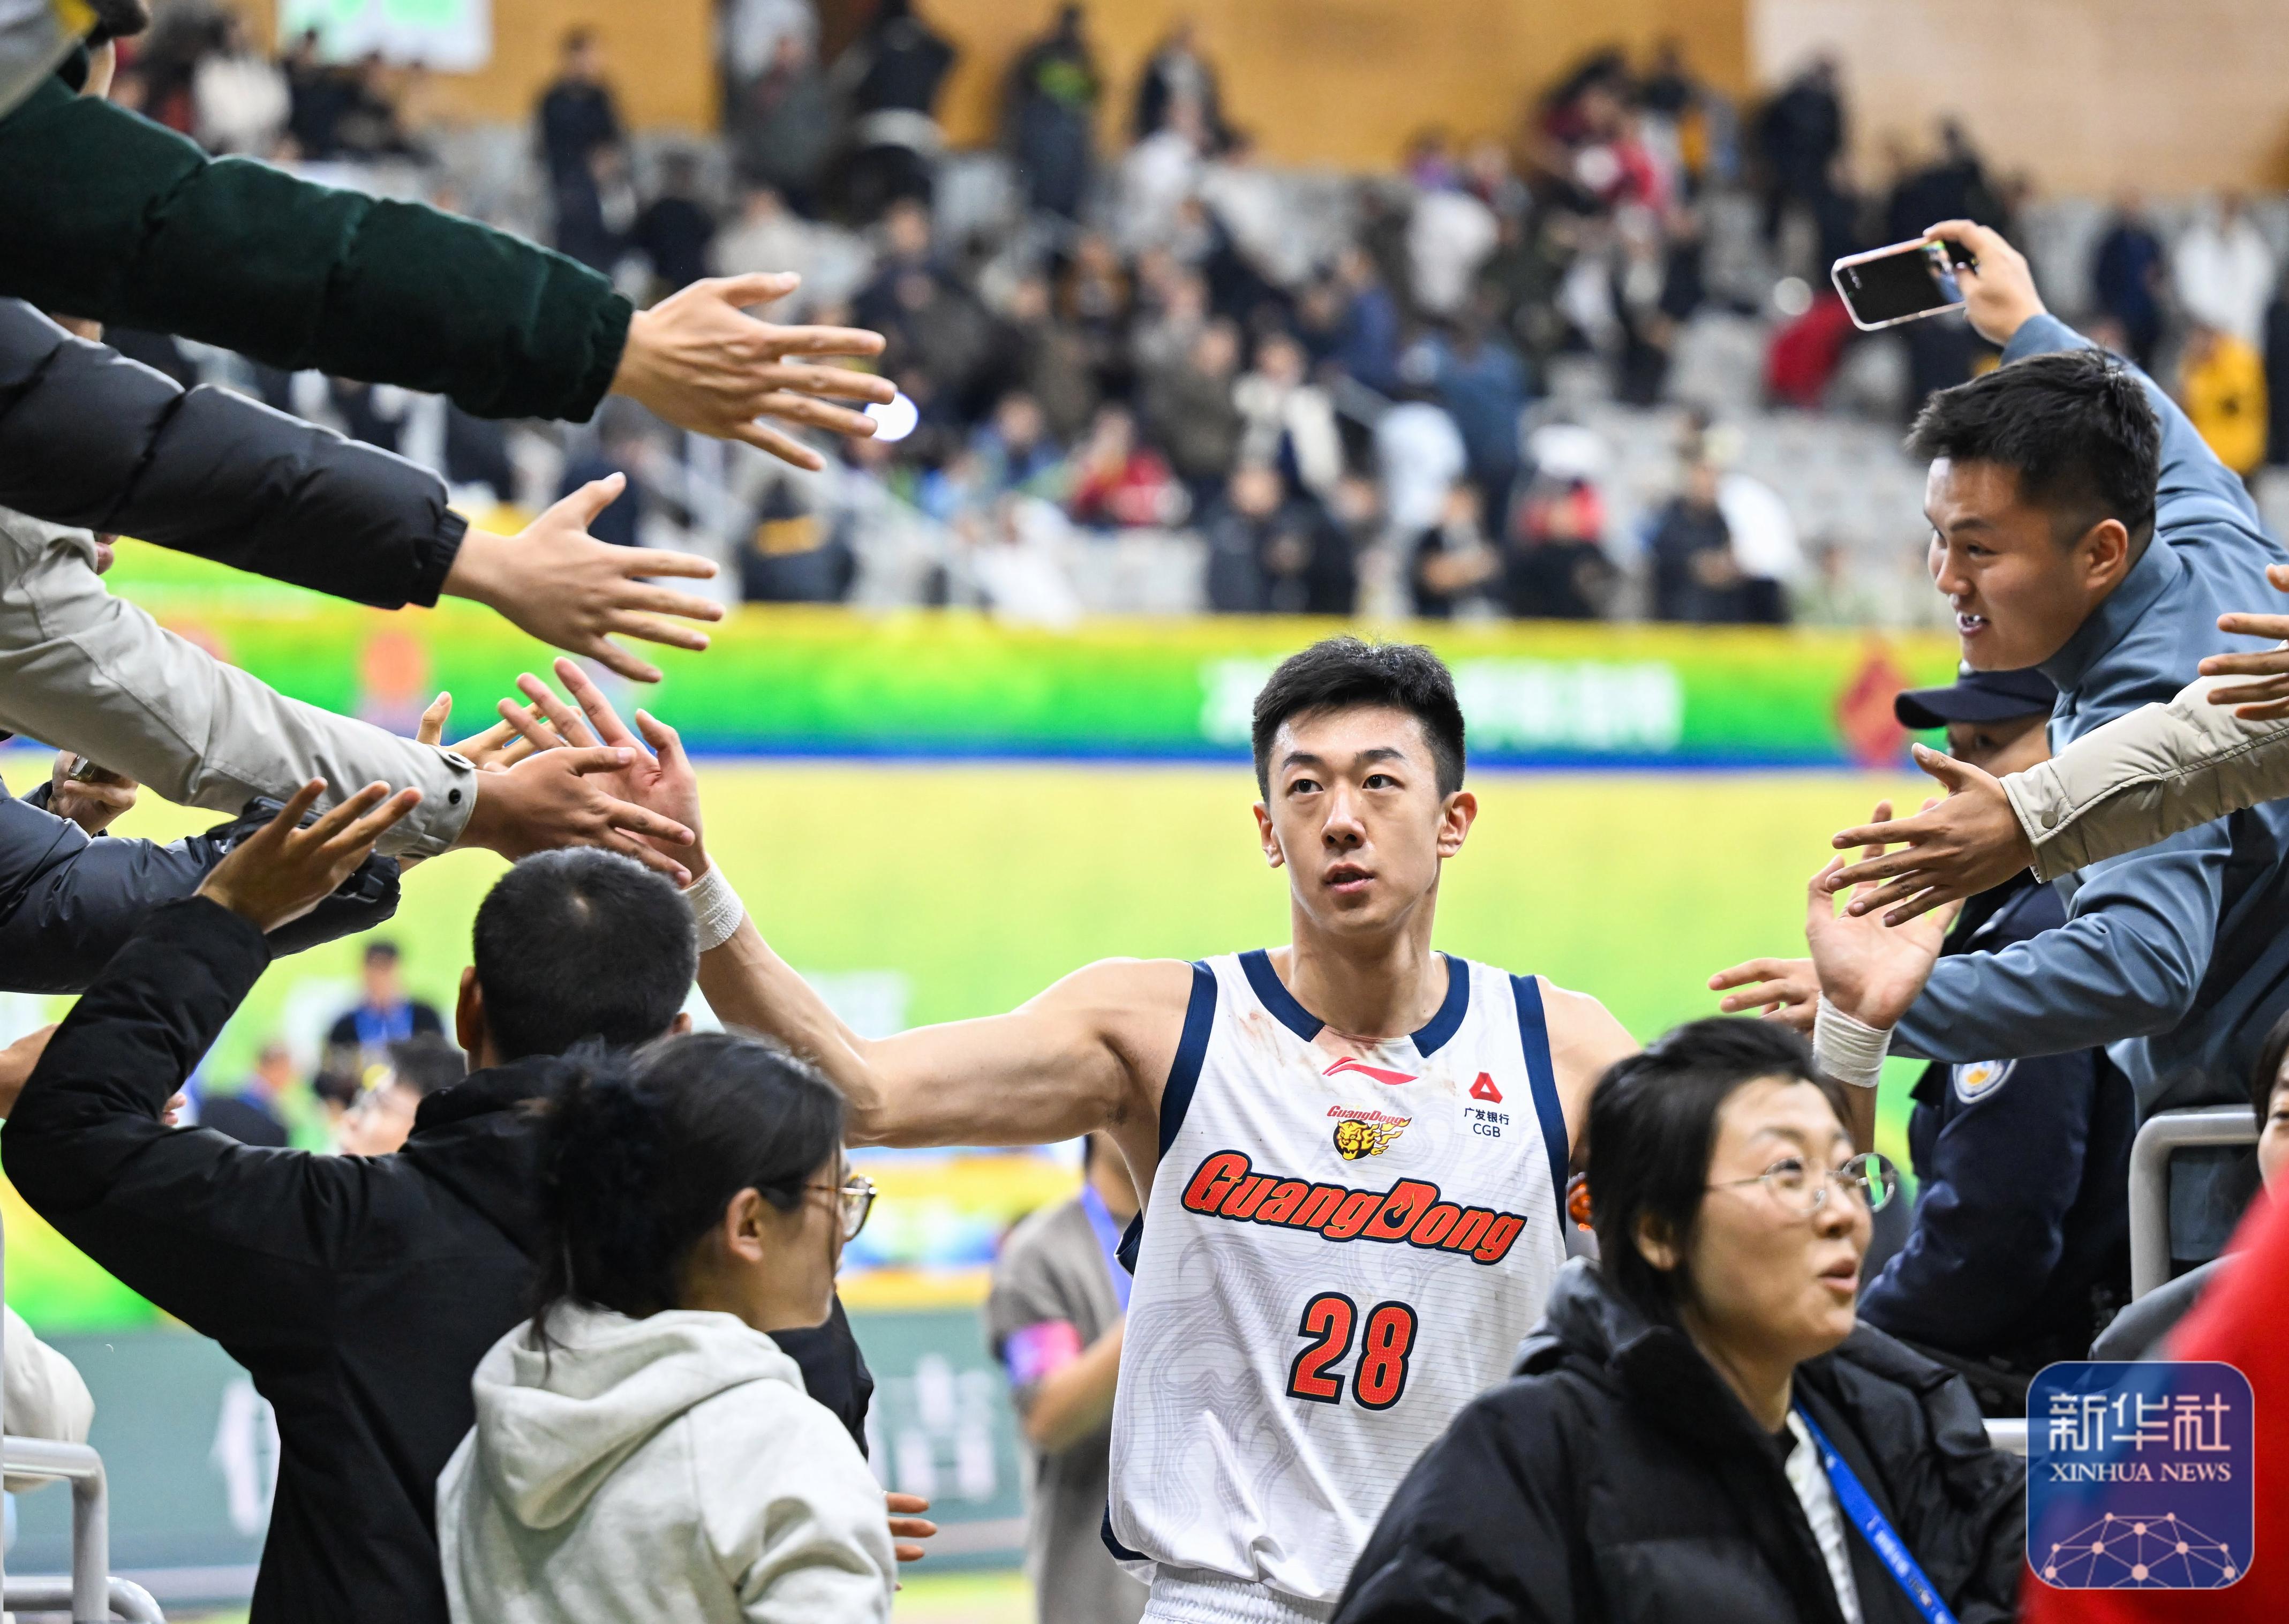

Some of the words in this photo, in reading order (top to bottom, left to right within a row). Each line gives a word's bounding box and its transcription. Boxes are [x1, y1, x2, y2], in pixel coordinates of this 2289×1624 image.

[1327, 1105, 1405, 1125] GuangDong
[1464, 1107, 1509, 1125] 广发银行
[1473, 1123, 1501, 1138] CGB
[1181, 1149, 1528, 1265] GuangDong
[1286, 1291, 1418, 1411] 28
